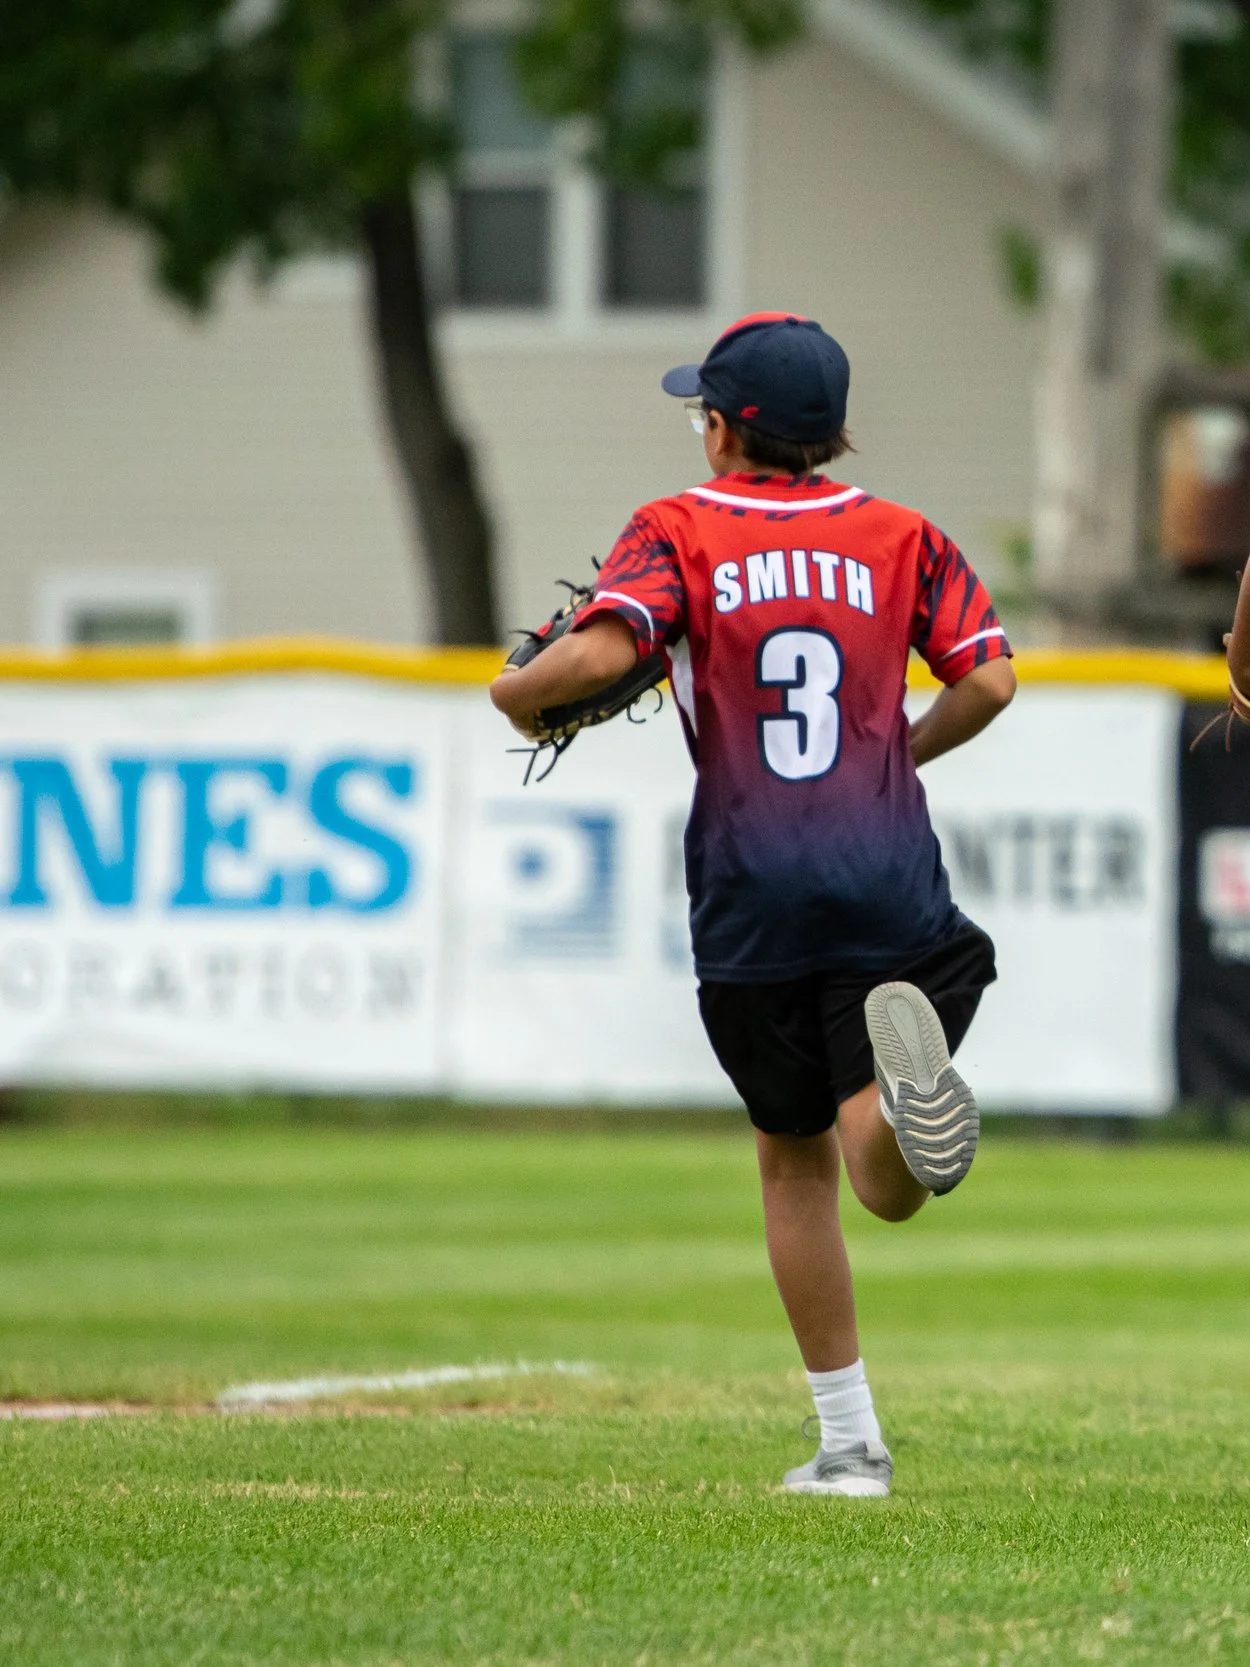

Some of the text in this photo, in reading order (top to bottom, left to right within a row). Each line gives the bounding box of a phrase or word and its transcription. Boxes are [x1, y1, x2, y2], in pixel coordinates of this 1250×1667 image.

[712, 548, 875, 618] SMITH
[754, 624, 844, 782] 3
[0, 754, 417, 911] NES
[940, 810, 1148, 906] NTER
